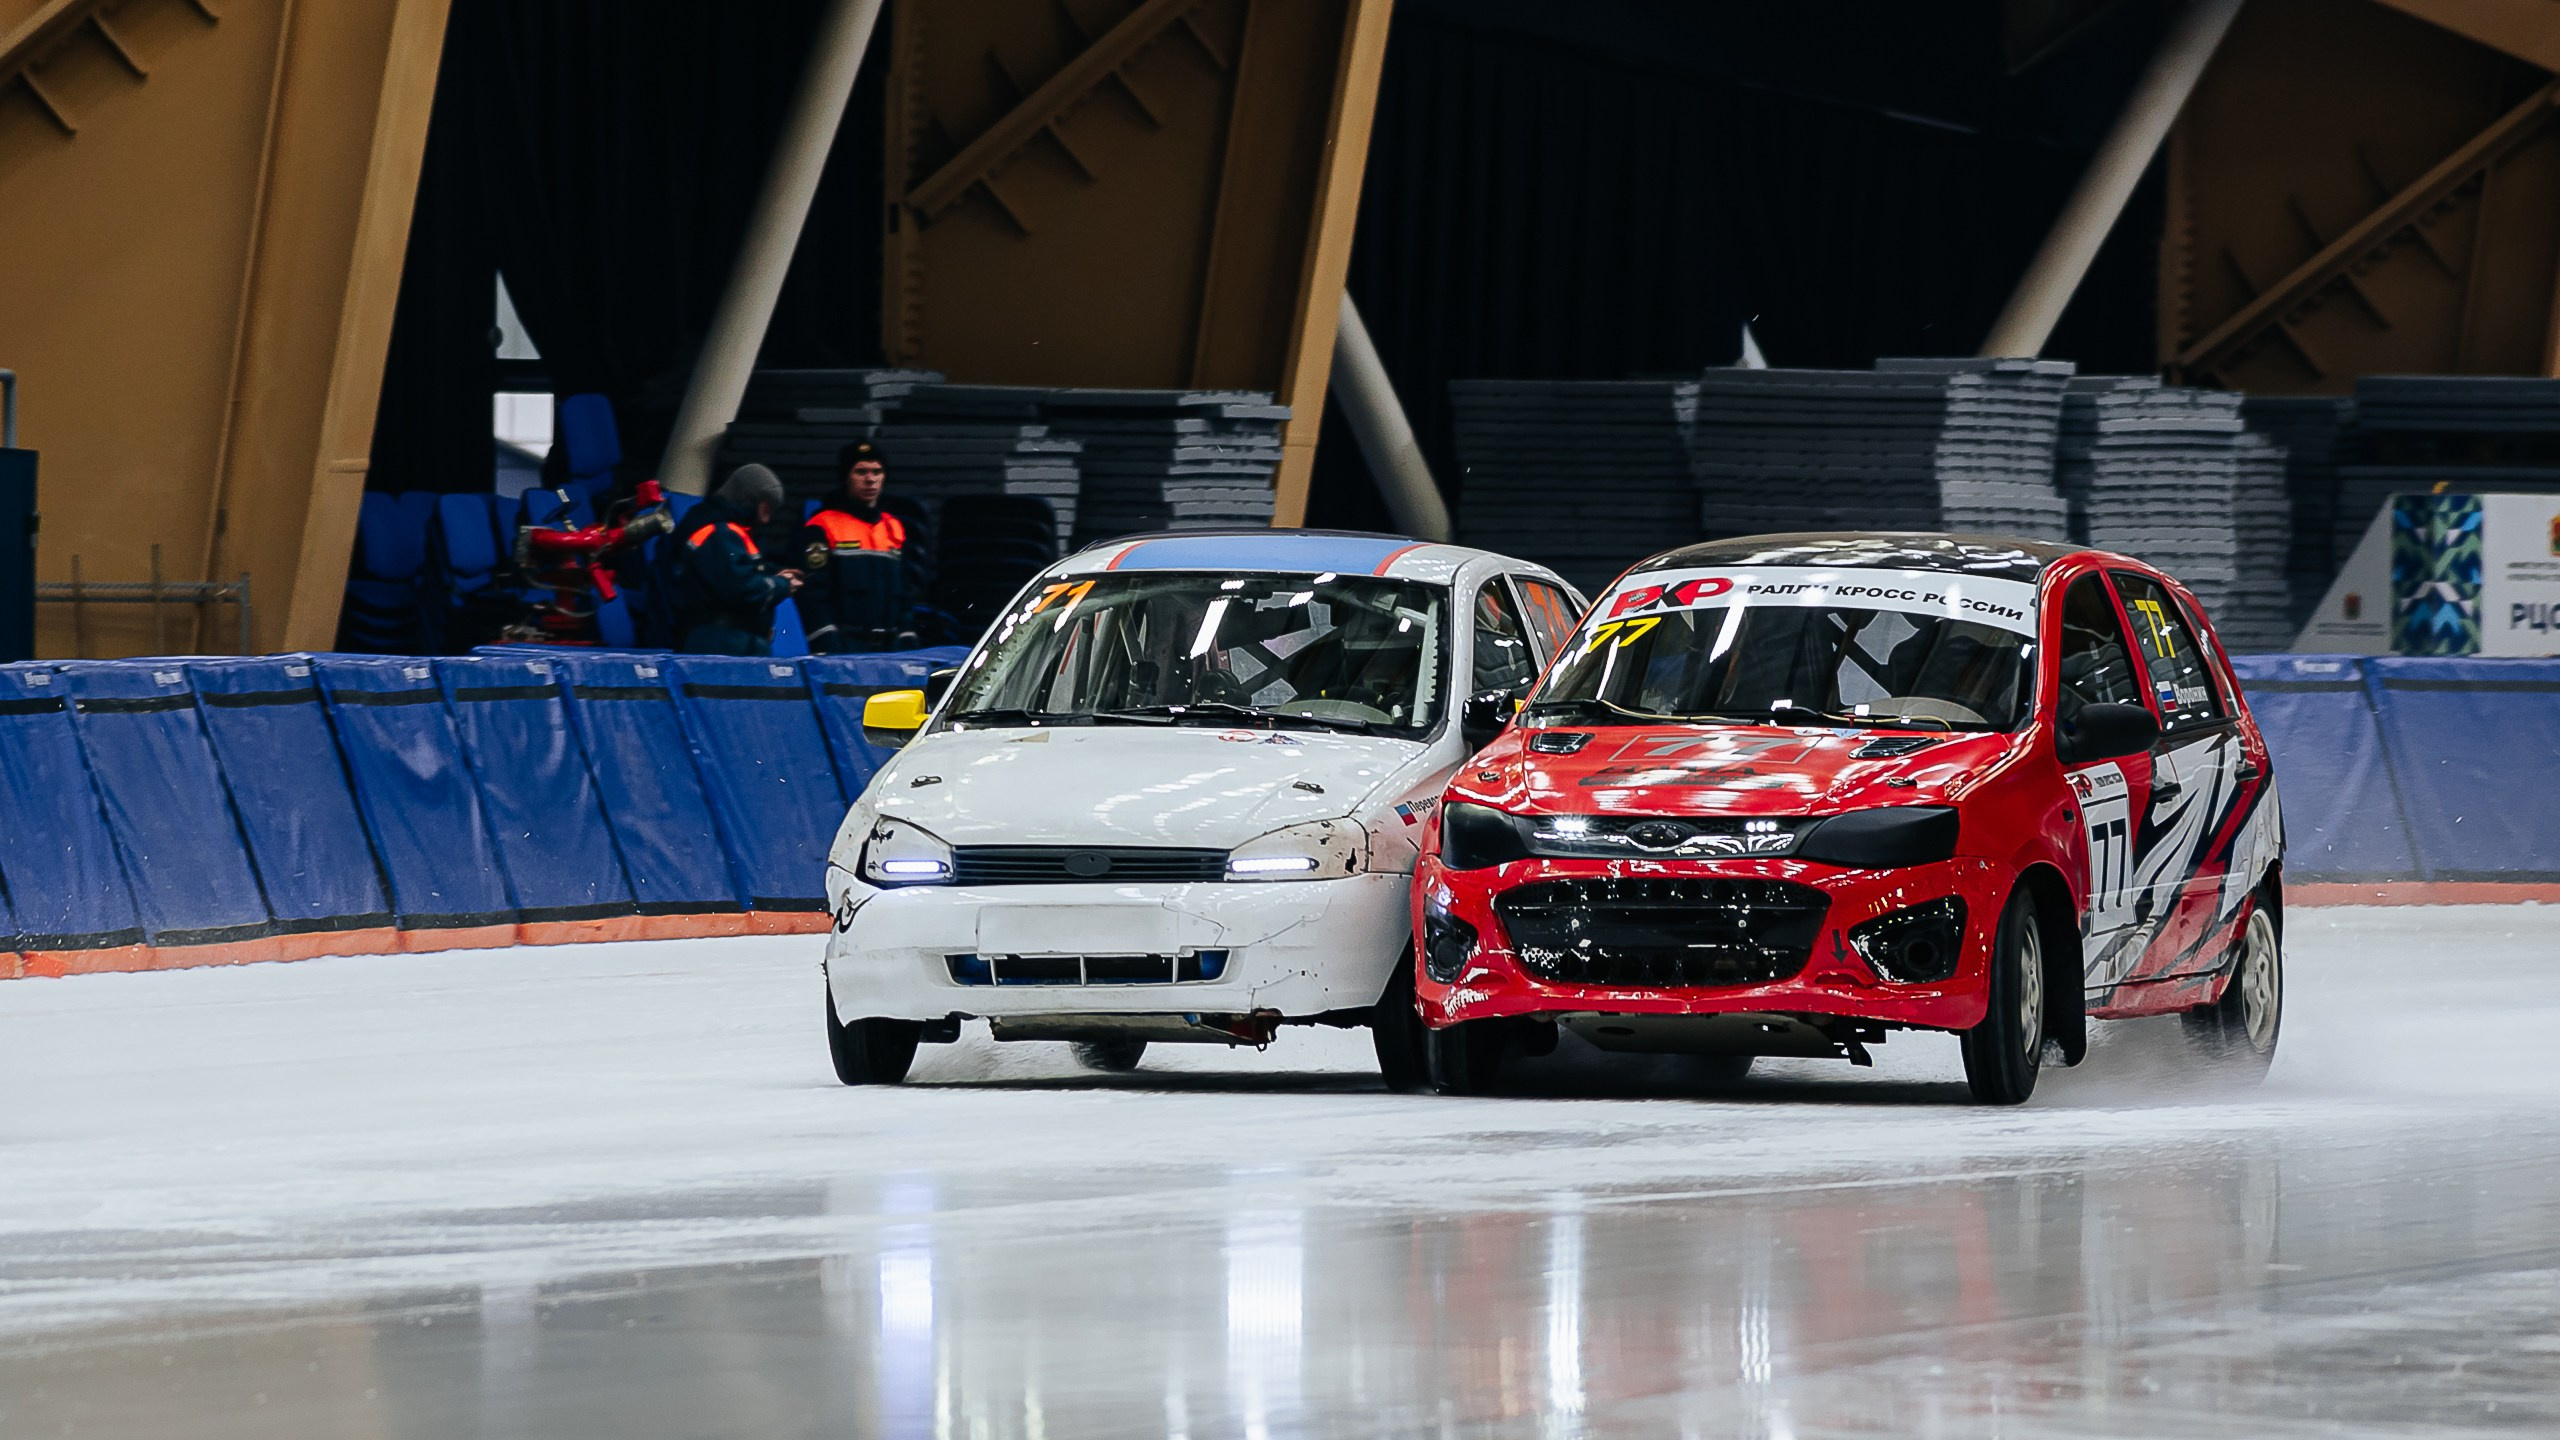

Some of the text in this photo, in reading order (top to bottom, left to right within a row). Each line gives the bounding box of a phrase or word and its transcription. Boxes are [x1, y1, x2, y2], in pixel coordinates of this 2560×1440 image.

[1835, 586, 1917, 601] КРОСС
[1588, 617, 1662, 653] 77
[2134, 599, 2176, 658] 77
[2091, 817, 2127, 913] 77
